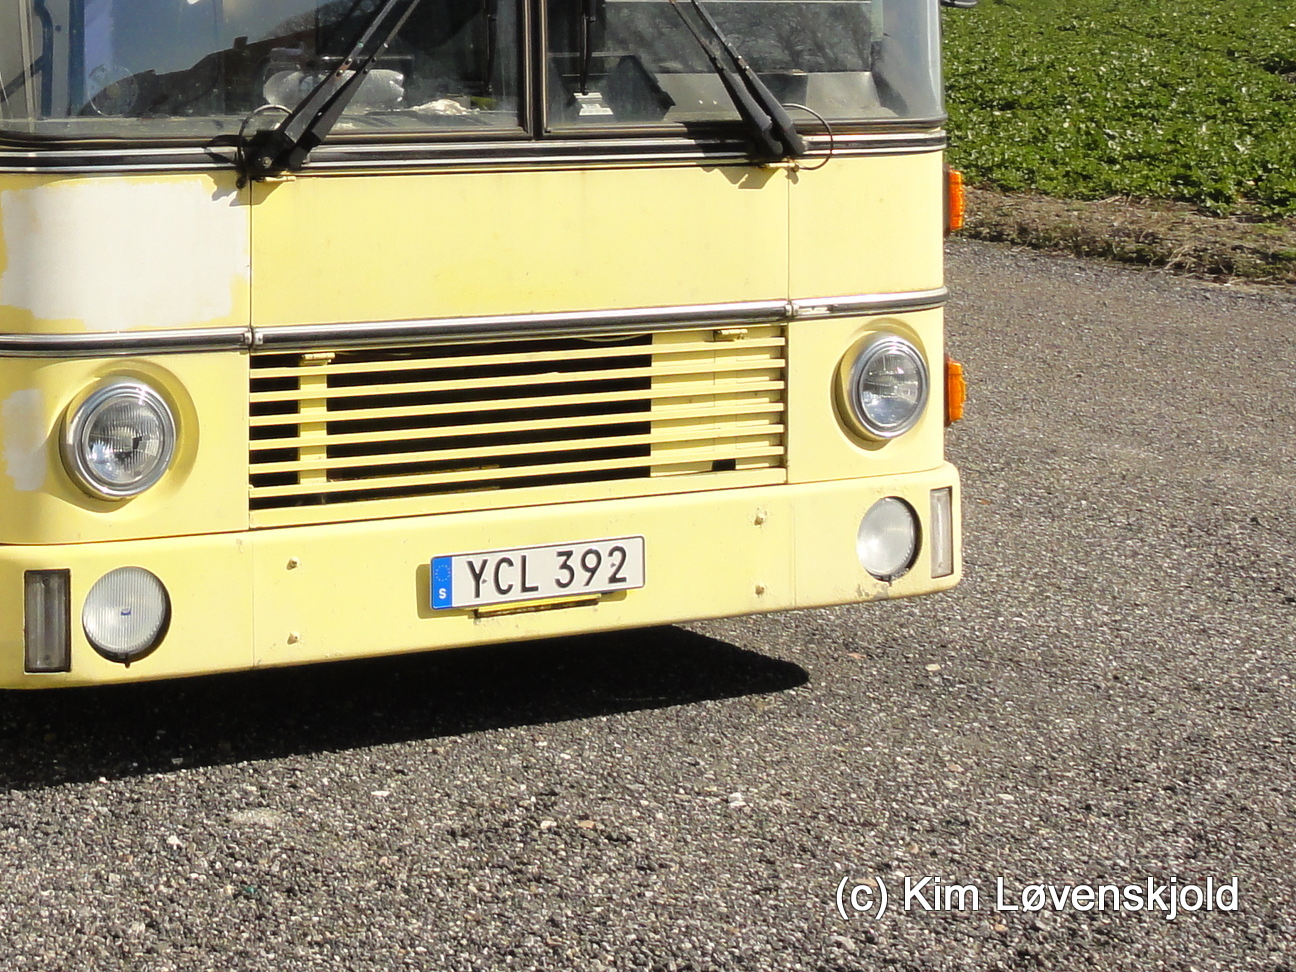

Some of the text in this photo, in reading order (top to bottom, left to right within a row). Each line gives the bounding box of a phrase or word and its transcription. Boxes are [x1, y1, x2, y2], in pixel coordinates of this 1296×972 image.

[466, 545, 628, 599] YCL 392
[438, 588, 447, 600] S
